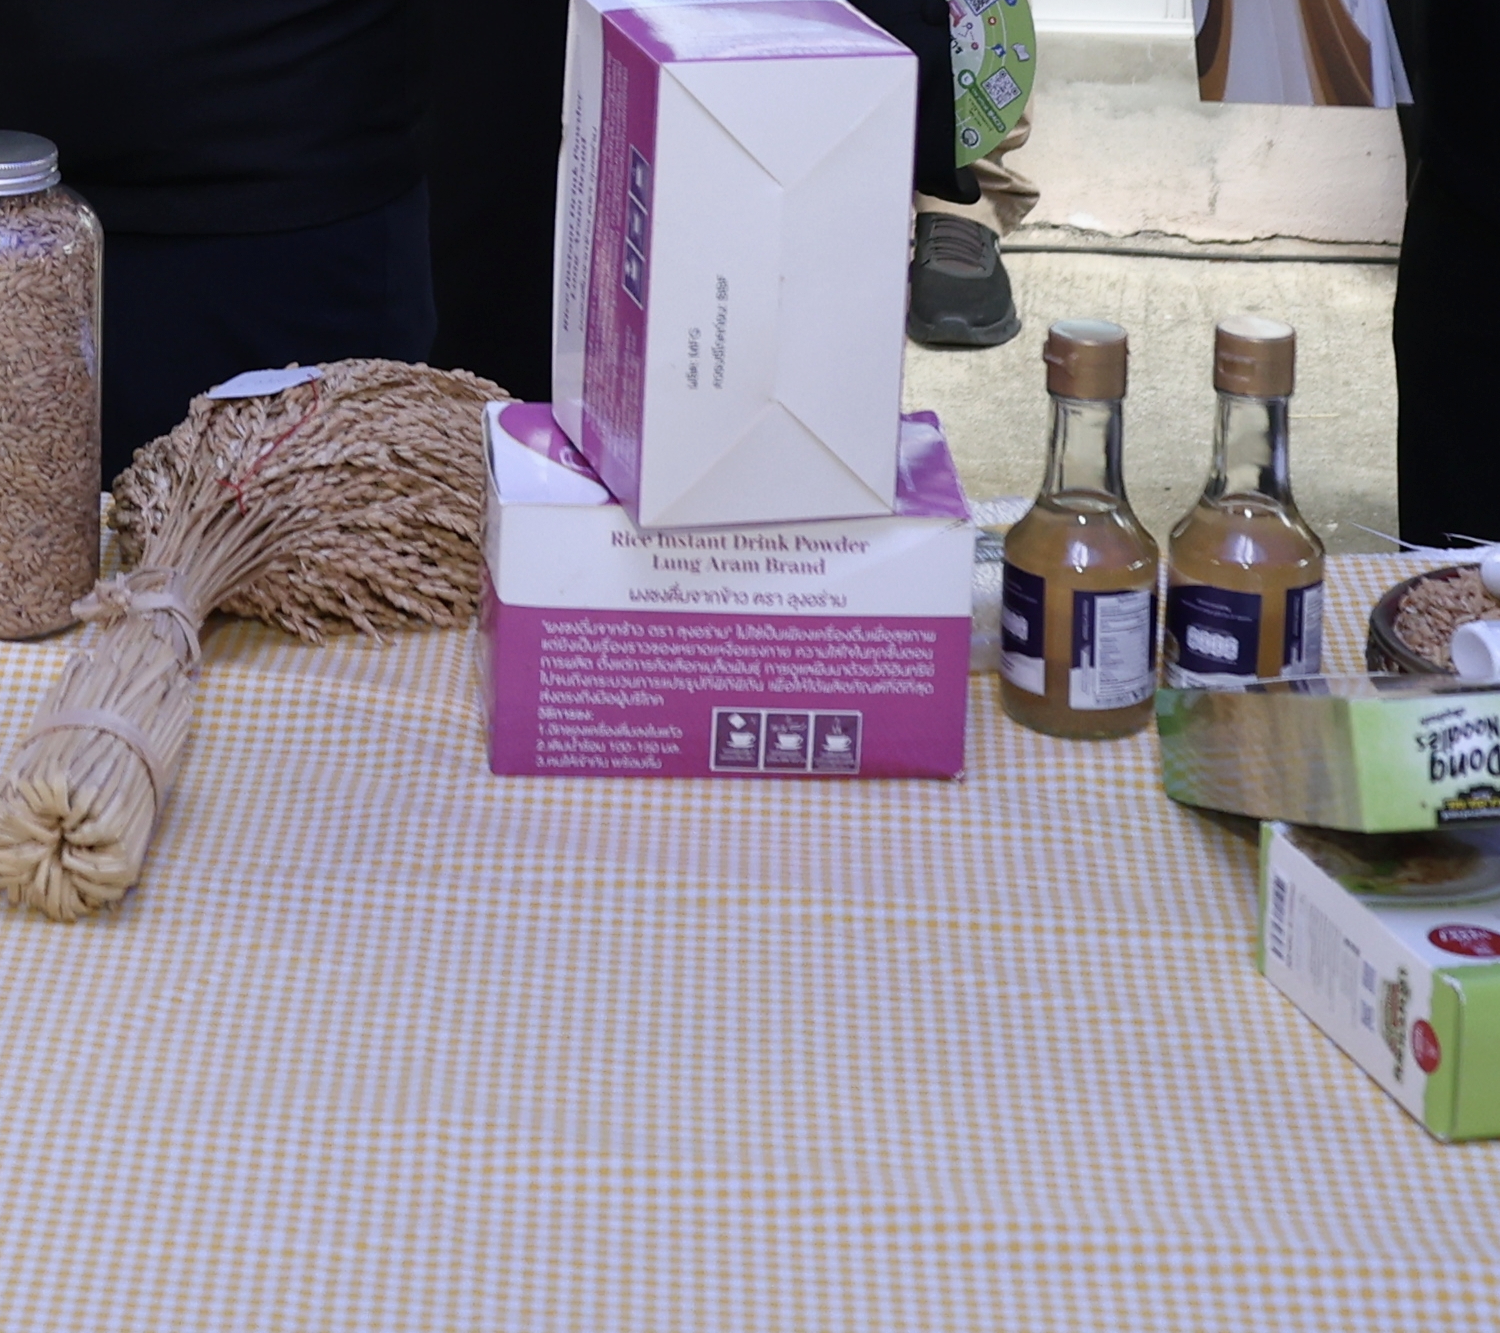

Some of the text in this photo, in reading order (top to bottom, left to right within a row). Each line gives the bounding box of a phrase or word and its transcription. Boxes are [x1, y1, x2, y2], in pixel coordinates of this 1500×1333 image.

[611, 530, 870, 554] Rice Instant Drink Powder
[651, 553, 826, 576] Lung Aram Brand
[752, 590, 783, 606] ตรา
[787, 589, 848, 611] ลุงอร่าม
